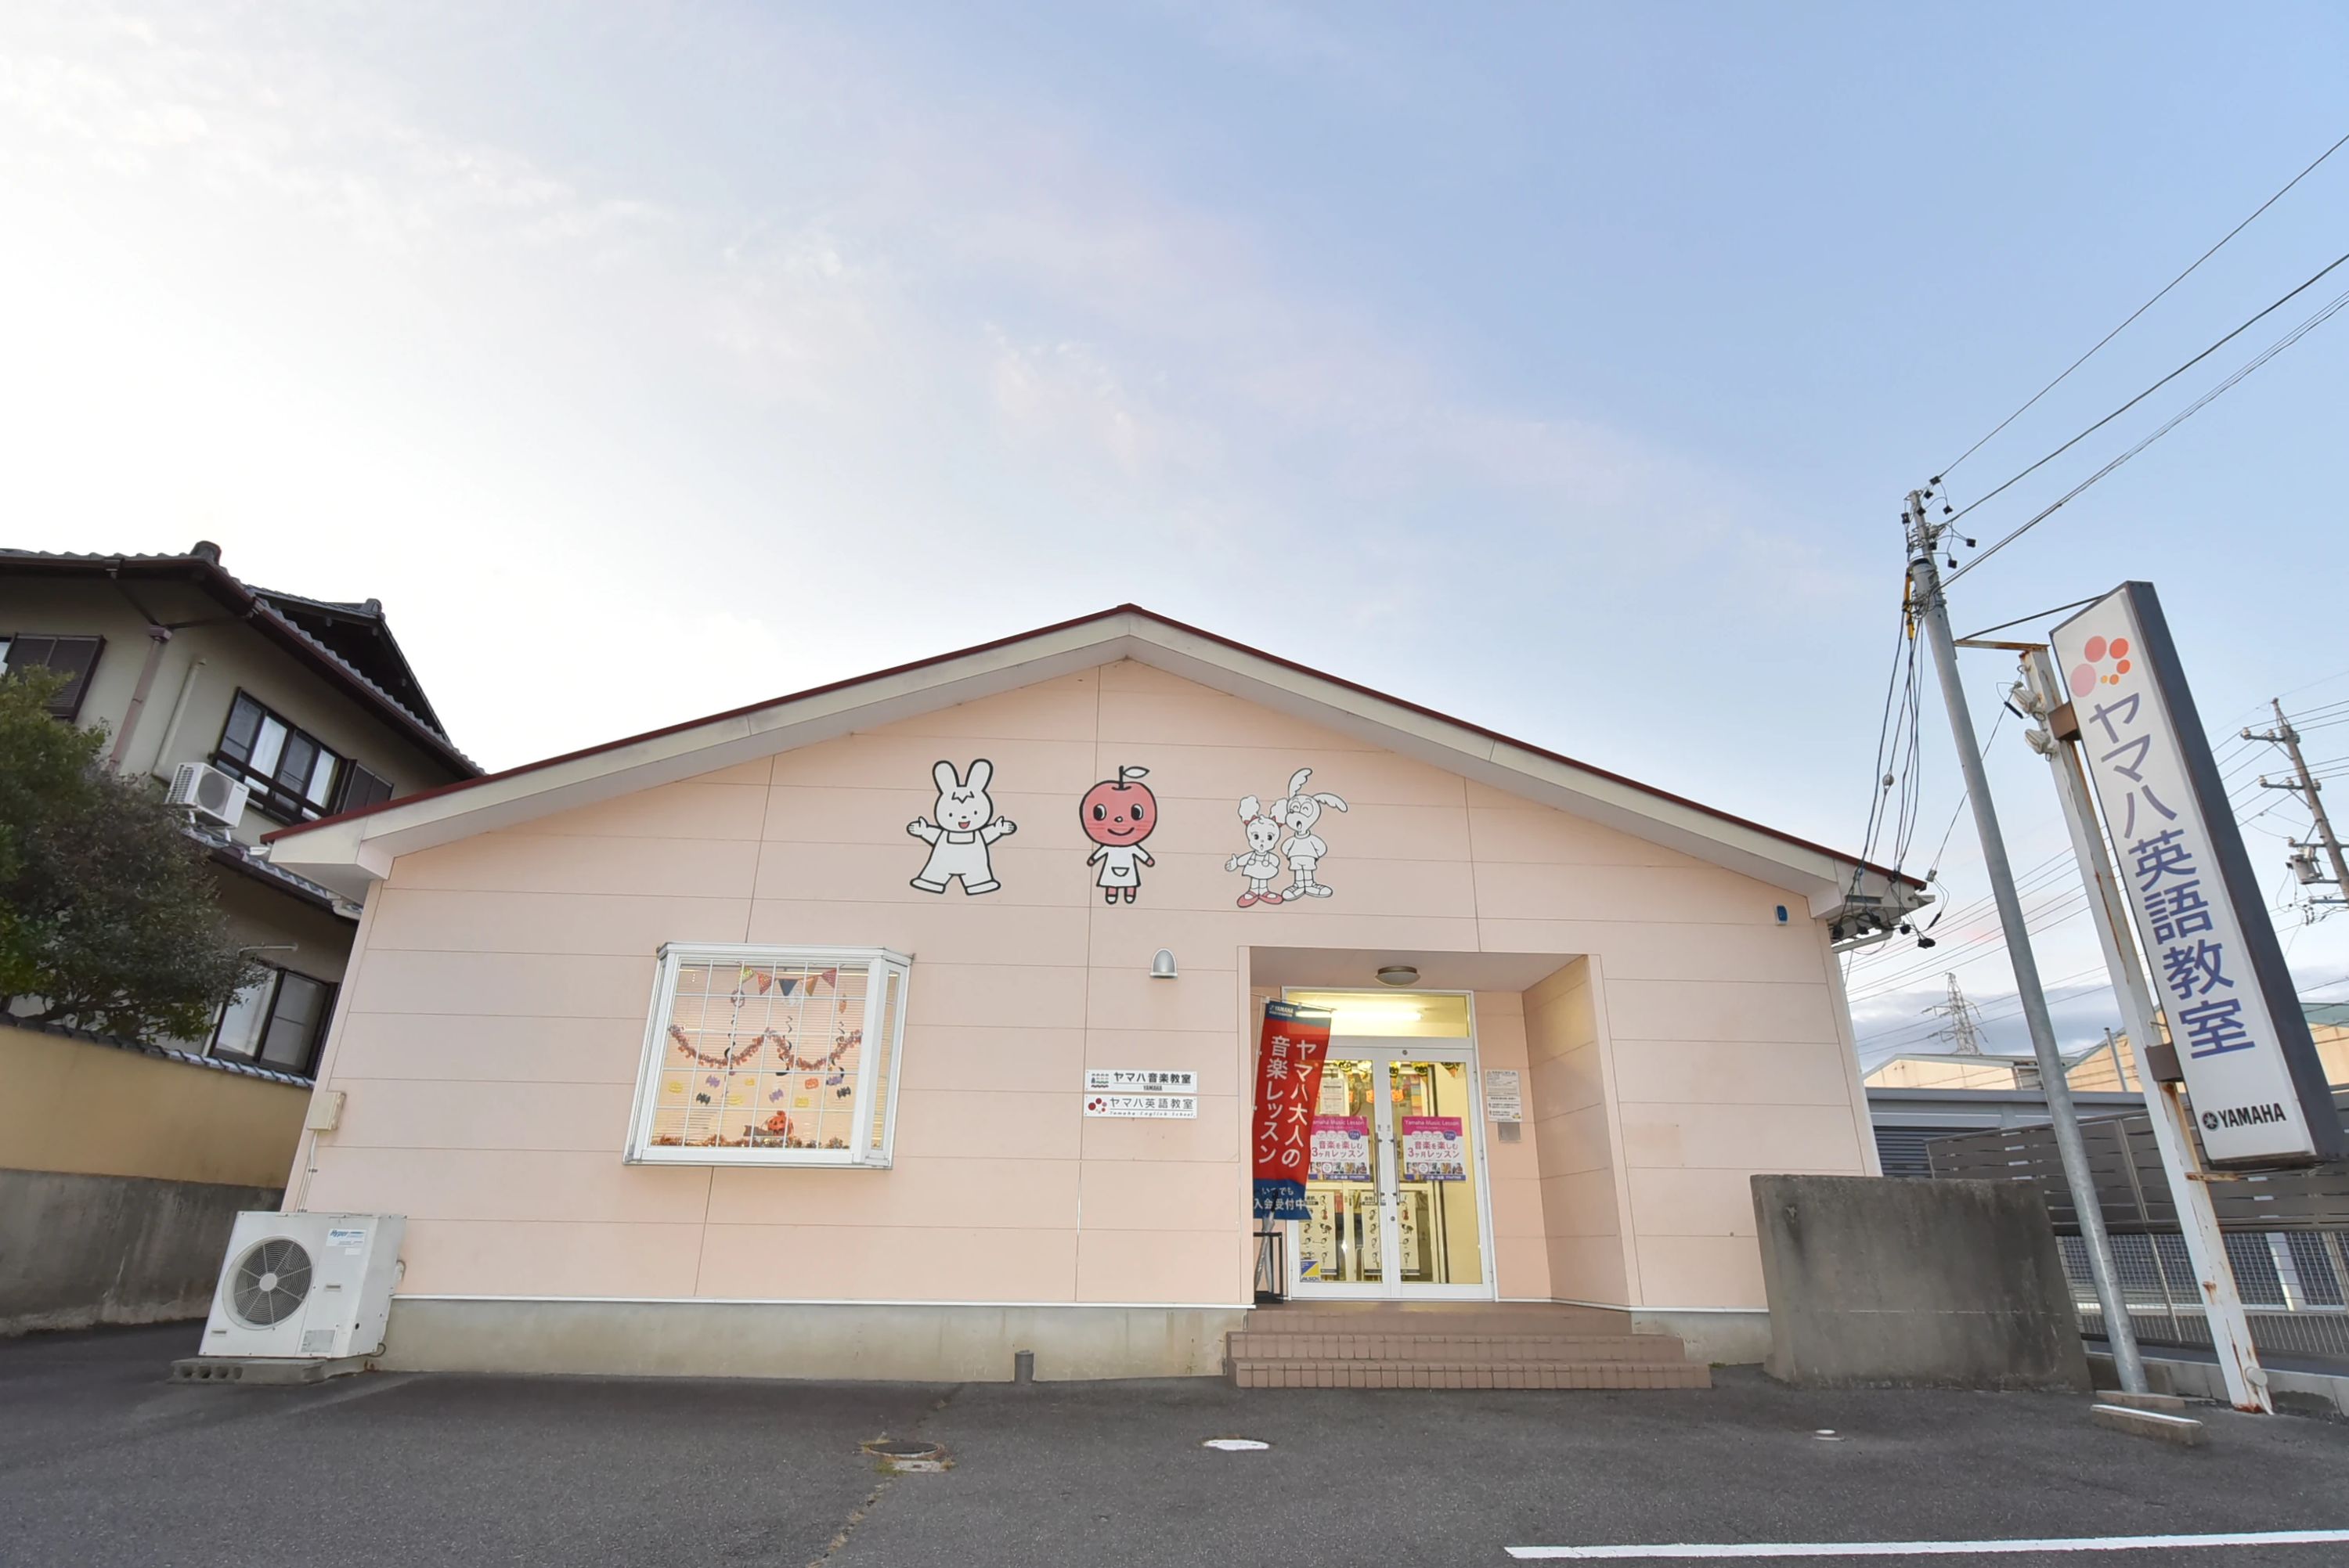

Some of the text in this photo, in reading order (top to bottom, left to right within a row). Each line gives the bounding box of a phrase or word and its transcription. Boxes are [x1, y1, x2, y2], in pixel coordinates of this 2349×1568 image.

[2088, 692, 2256, 1059] ヤマハ英語教室
[1113, 1072, 1192, 1084] ヤマハ音楽教室
[1110, 1098, 1193, 1109] ヤマハ英語教室
[1258, 1036, 1290, 1163] 音楽レッスン
[1282, 1040, 1317, 1167] ヤマハ大人の
[2217, 1103, 2286, 1128] YAMAHA
[1319, 1141, 1362, 1149] 音楽を楽しむ
[1415, 1141, 1459, 1150] 音楽を楽しむ
[1254, 1198, 1306, 1211] 入会受付中
